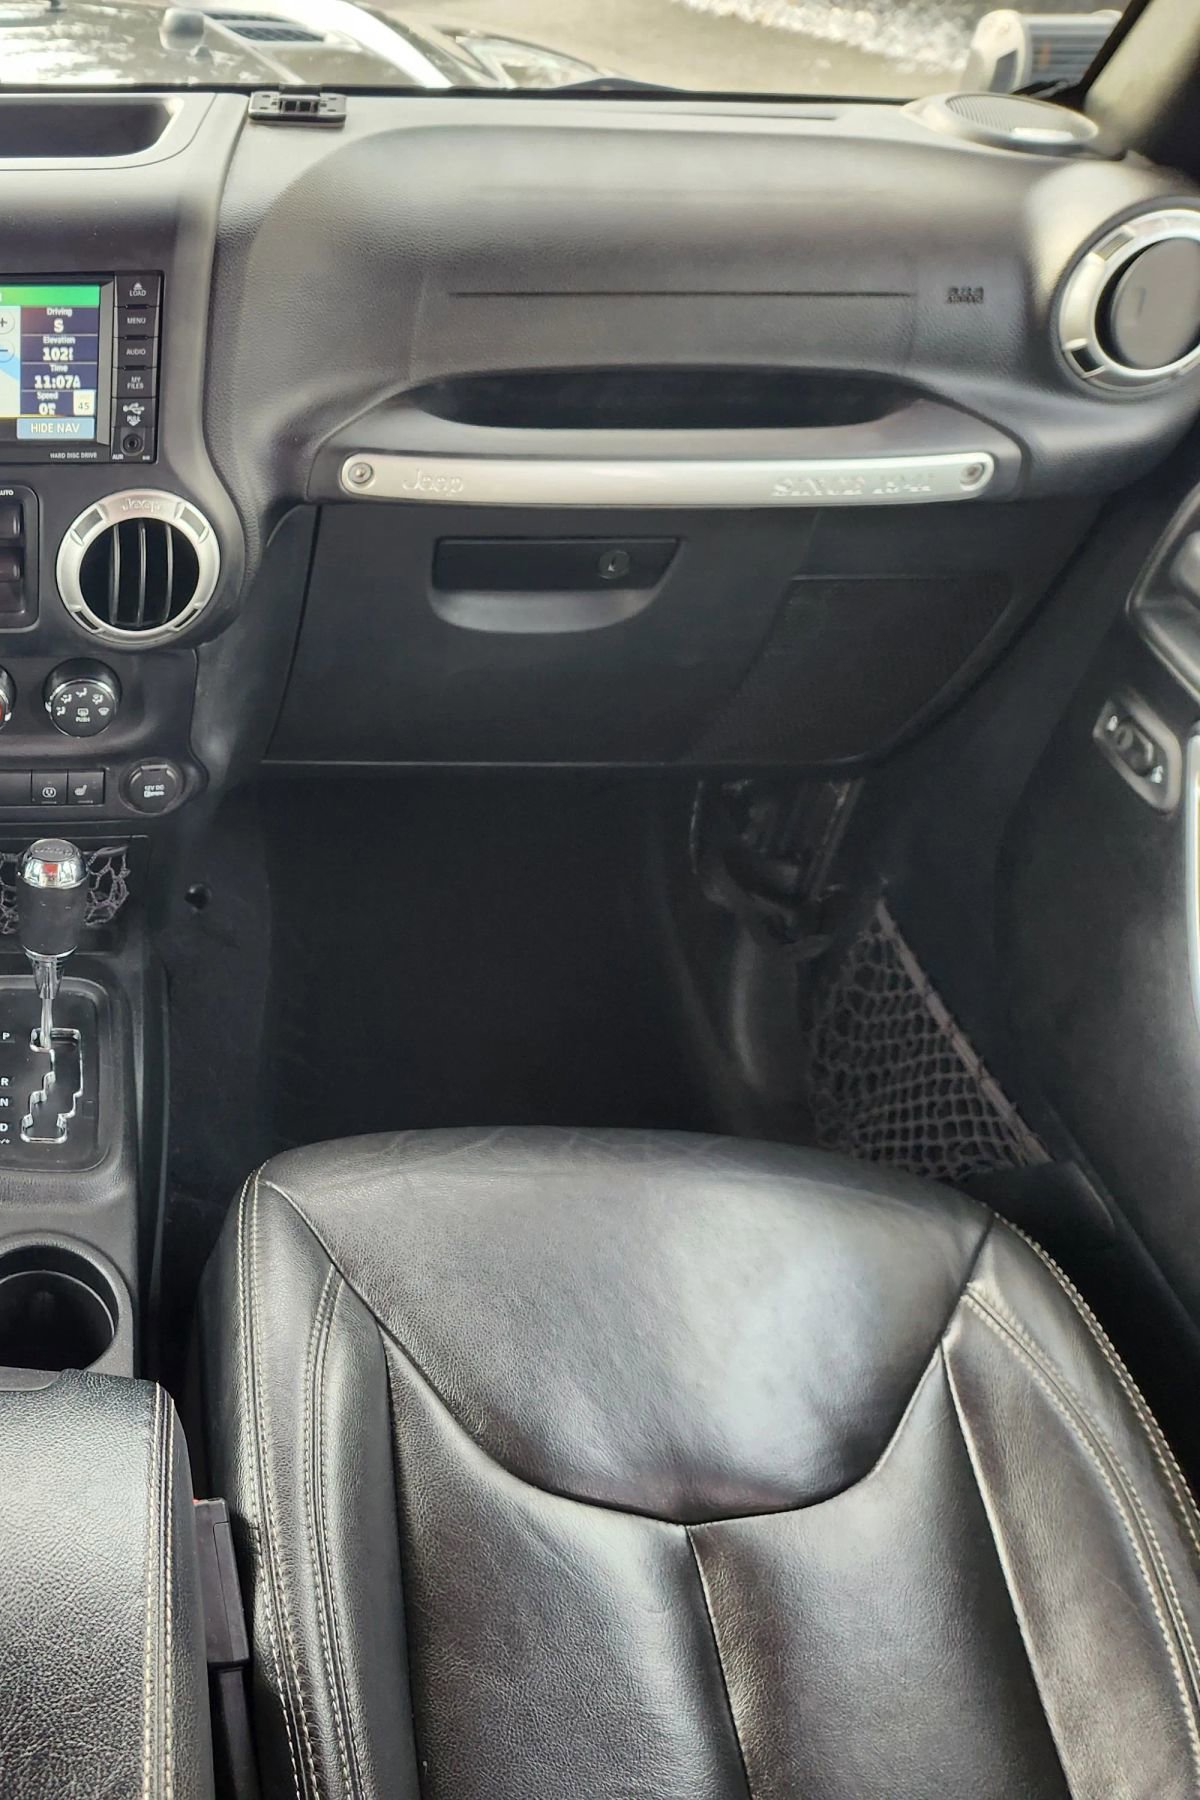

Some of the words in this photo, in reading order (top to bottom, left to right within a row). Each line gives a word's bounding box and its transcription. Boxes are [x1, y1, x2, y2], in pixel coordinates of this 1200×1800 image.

[46, 307, 73, 317] Driving
[43, 336, 76, 344] Elevation
[49, 364, 68, 373] Time
[127, 382, 144, 390] FILES
[36, 391, 59, 401] Speed
[78, 402, 90, 410] 45
[31, 423, 54, 433] HIDE
[56, 423, 80, 433] NAV
[402, 468, 464, 497] Jeep
[2, 1032, 10, 1040] P
[0, 1077, 9, 1086] R
[0, 1098, 9, 1107] N
[0, 1122, 9, 1132] D
